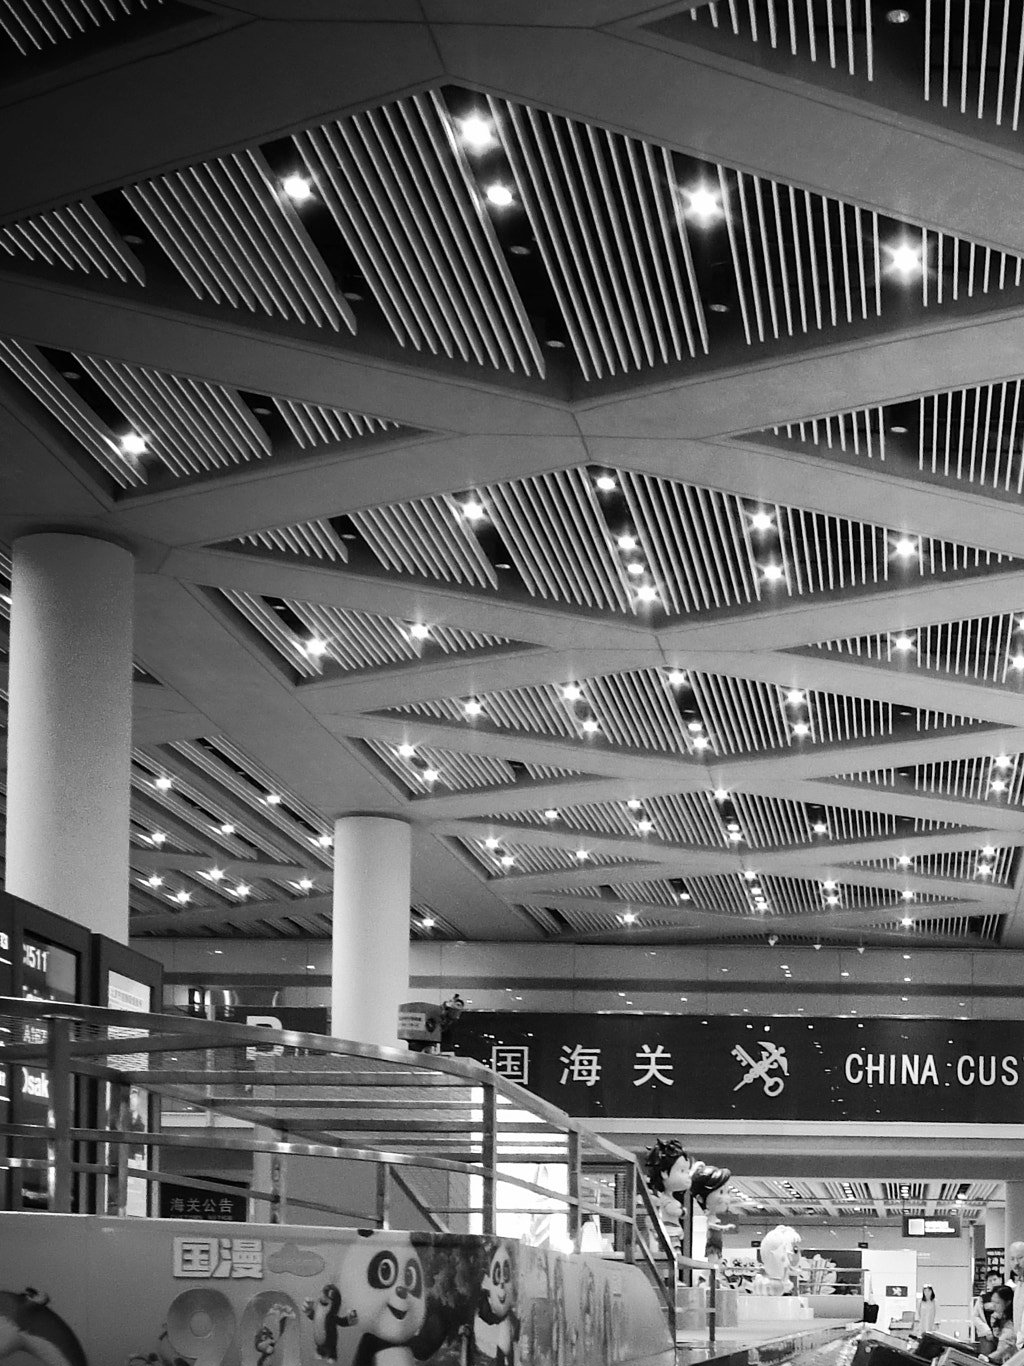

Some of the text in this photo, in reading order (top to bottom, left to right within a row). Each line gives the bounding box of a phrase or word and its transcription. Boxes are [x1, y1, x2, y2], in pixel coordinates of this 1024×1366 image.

[491, 1043, 674, 1087] 国海关
[844, 1053, 939, 1085] CHINA
[169, 1197, 234, 1213] 海关公告
[172, 1237, 263, 1278] 国漫
